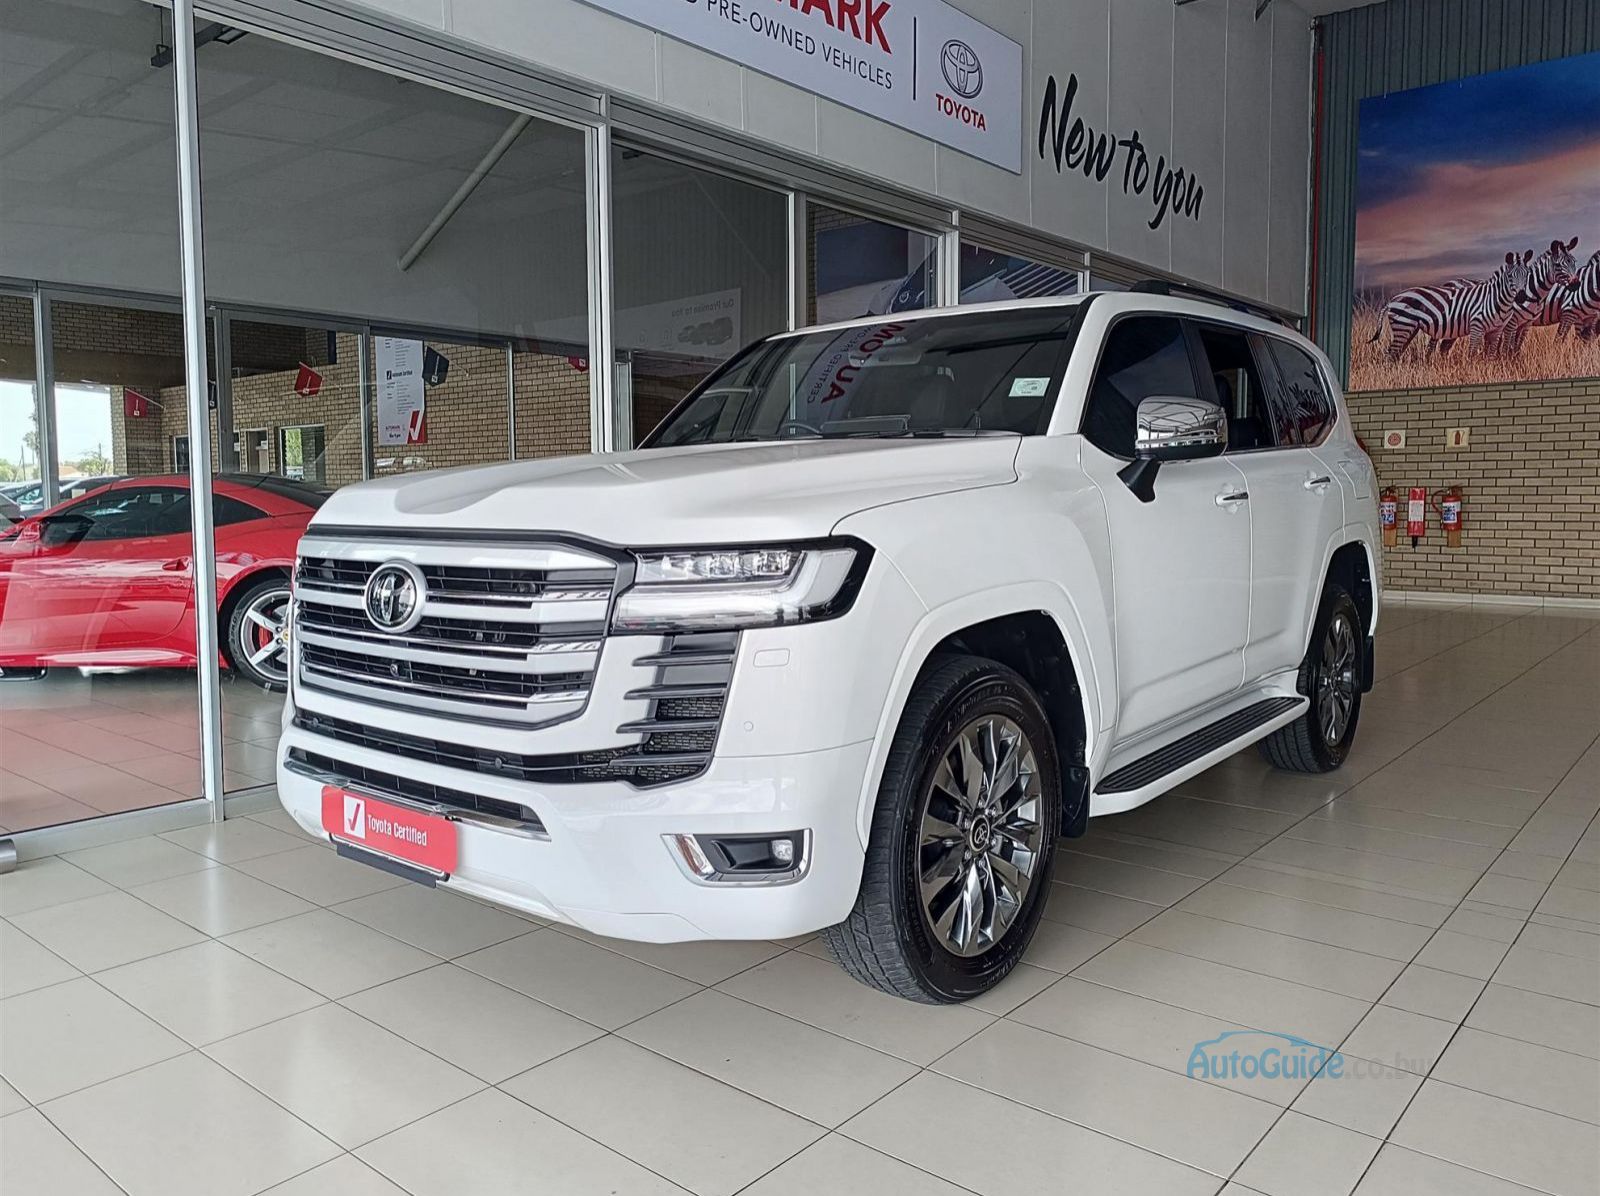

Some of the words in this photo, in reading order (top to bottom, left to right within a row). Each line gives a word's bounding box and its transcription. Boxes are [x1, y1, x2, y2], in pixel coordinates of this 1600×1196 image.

[707, 0, 816, 55] PRE-OWNED
[822, 42, 893, 90] VEHICLES
[935, 93, 986, 132] TOYOTA
[1038, 73, 1116, 182] New
[1118, 130, 1150, 195] to
[1148, 155, 1204, 230] you
[367, 814, 392, 836] Toyota
[393, 822, 427, 847] Certified
